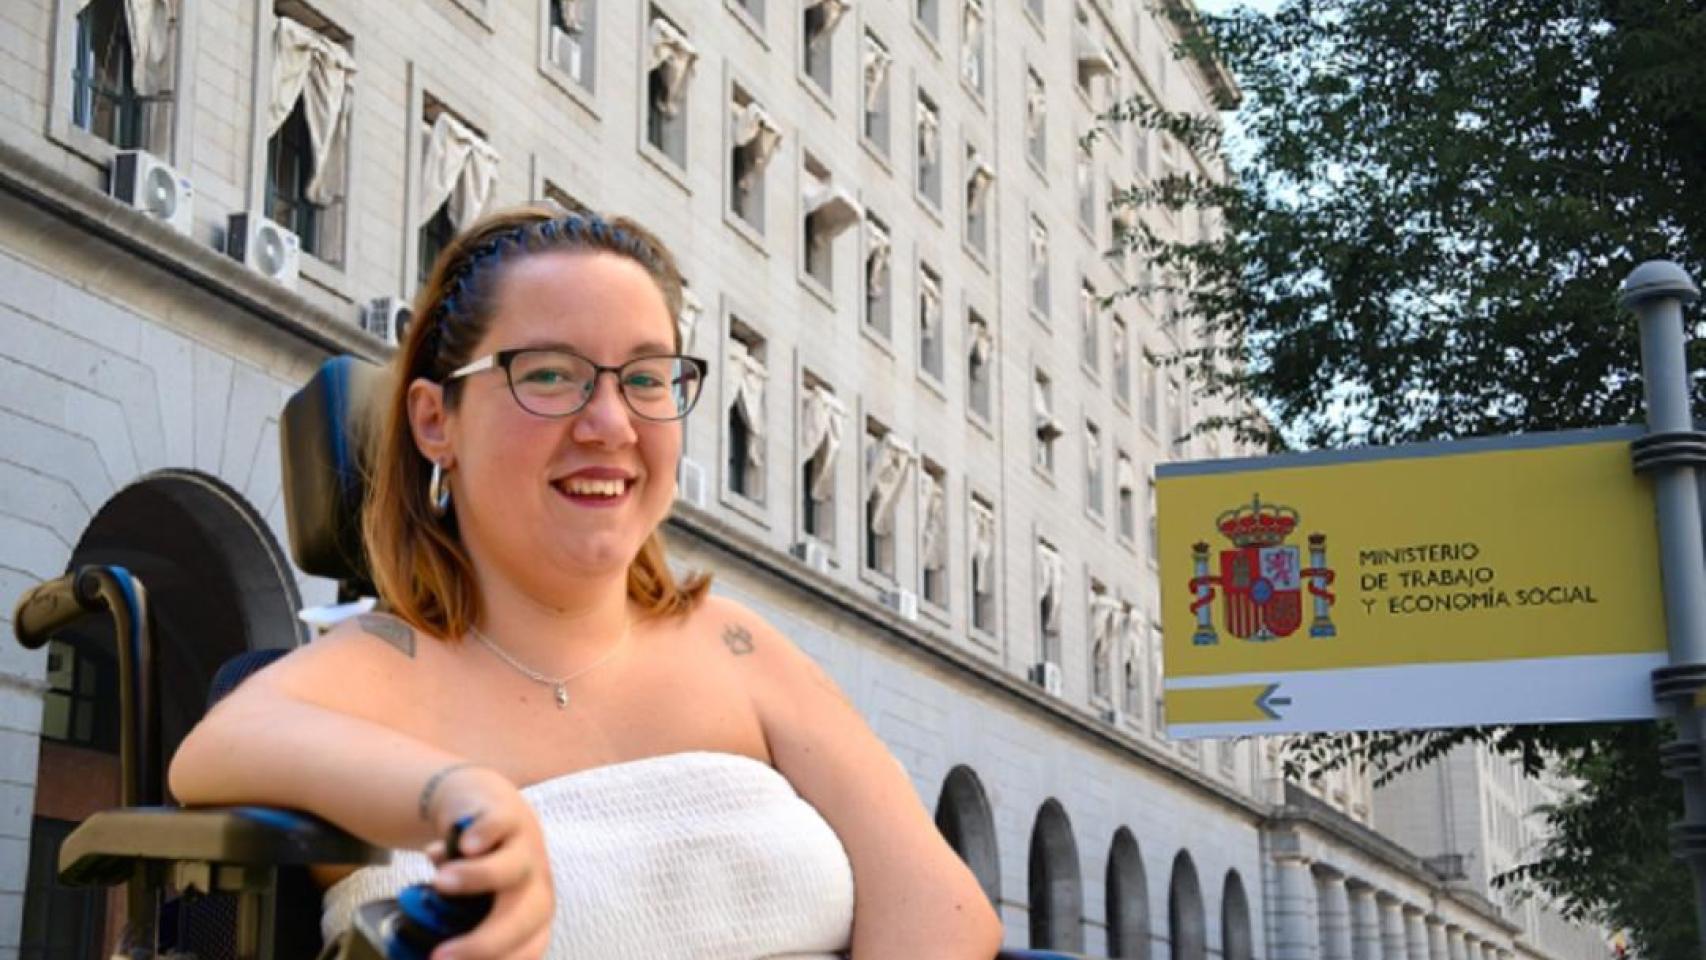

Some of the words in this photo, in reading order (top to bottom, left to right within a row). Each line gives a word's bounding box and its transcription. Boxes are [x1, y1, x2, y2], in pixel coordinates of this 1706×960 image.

[1359, 542, 1480, 567] MINISTERIO
[1361, 572, 1388, 591] DE
[1399, 567, 1494, 588] TRABAJO
[1361, 599, 1376, 616] Y
[1389, 587, 1511, 614] ECONOMÍA
[1516, 586, 1598, 606] SOCIAL
